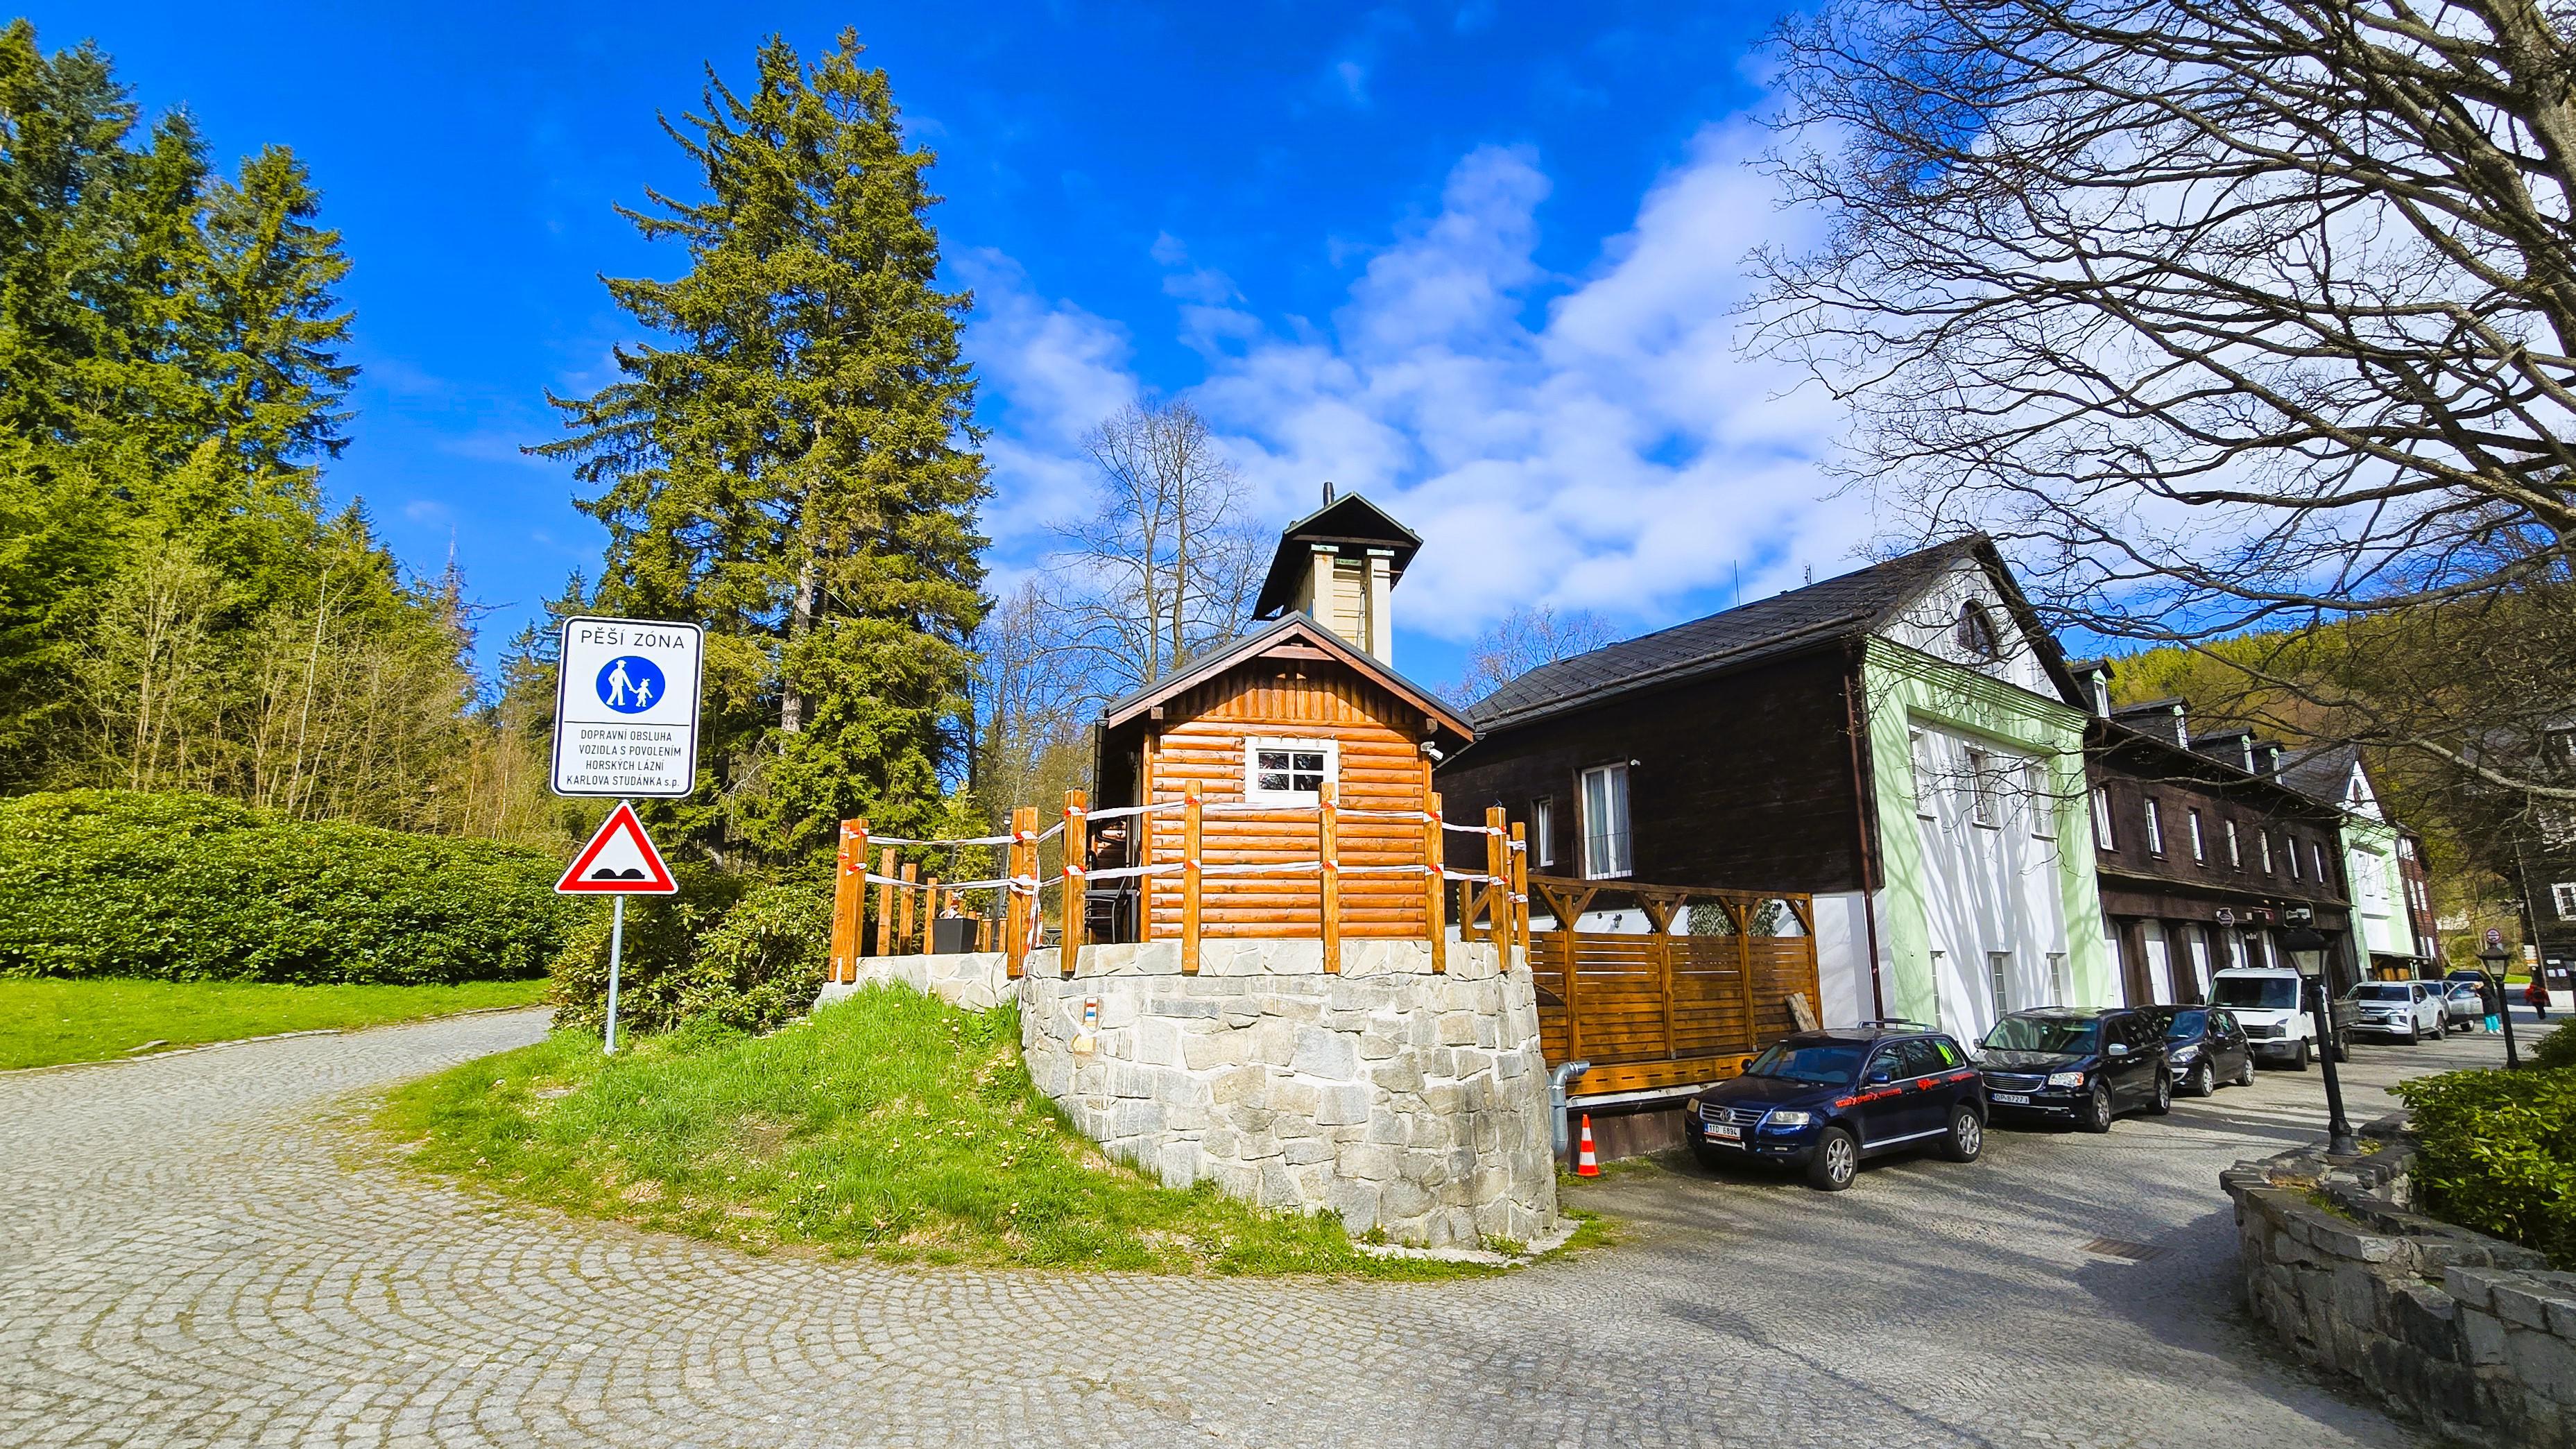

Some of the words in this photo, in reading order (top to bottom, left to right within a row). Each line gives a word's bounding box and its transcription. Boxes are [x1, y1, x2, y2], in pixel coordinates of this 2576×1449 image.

[581, 627, 625, 645] PĚŠÍ
[634, 631, 685, 649] ZÓNA
[581, 729, 628, 741] DOPRAVNÍ
[630, 731, 672, 741] OBSLUHA
[579, 744, 617, 755] VOZIDLA
[620, 746, 626, 755] S
[629, 745, 681, 757] POVOLENÍM
[585, 759, 635, 771] HORSKÝCH
[637, 759, 664, 771] LÁZNÍ
[567, 775, 609, 785] KARLOVA
[612, 773, 662, 786] STUDÁNKA
[664, 779, 680, 789] s.p.
